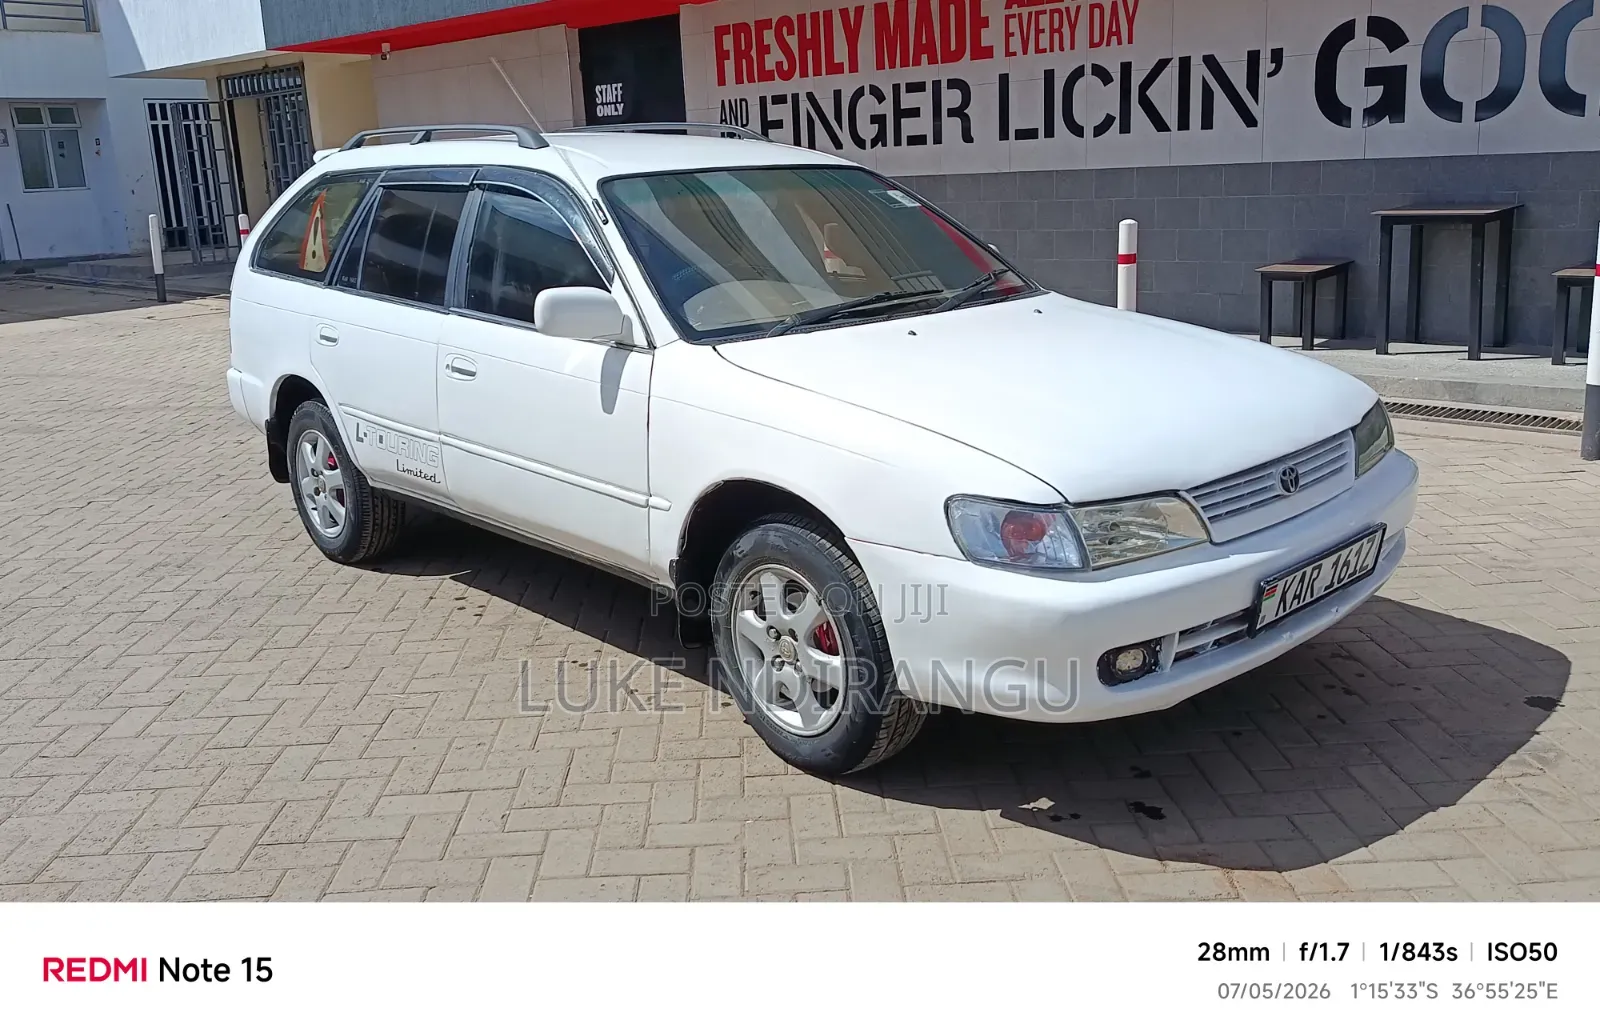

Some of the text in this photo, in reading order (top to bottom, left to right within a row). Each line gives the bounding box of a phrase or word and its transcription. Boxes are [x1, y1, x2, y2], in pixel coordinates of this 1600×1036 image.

[714, 0, 994, 87] FRESHLY MADE
[1004, 0, 1140, 58] EVERY DAY
[595, 83, 623, 104] STAFF
[596, 103, 625, 117] ONLY
[720, 97, 750, 128] AND
[759, 78, 974, 151] FINGER
[998, 47, 1284, 142] LICKIN'
[396, 459, 441, 484] Limited
[1275, 534, 1377, 618] KAR 161Z
